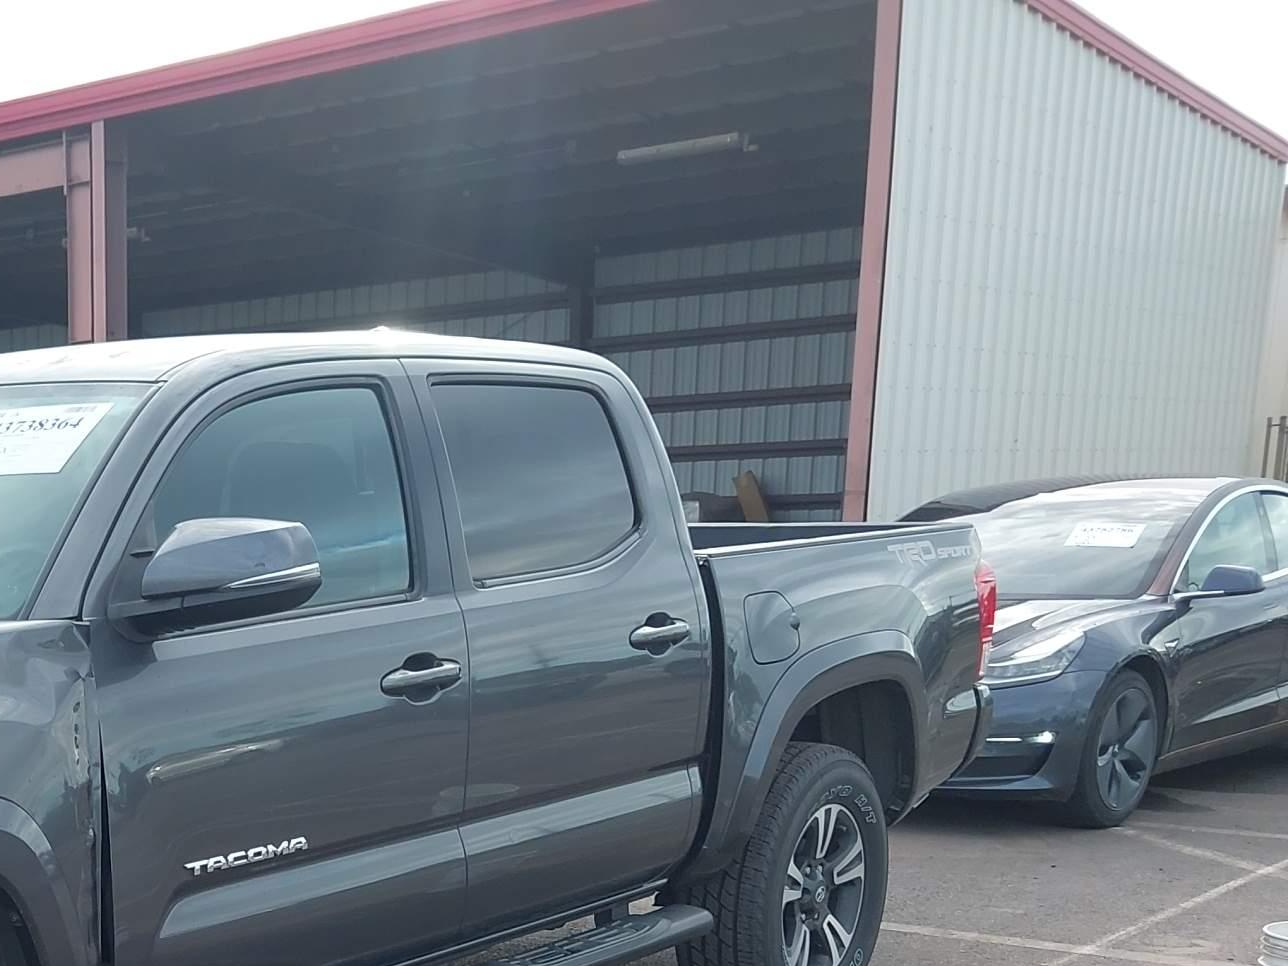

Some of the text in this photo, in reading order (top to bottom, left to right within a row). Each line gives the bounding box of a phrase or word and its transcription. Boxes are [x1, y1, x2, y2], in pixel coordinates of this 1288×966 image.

[887, 540, 973, 567] TRD SPORT
[183, 835, 309, 876] TACOMA
